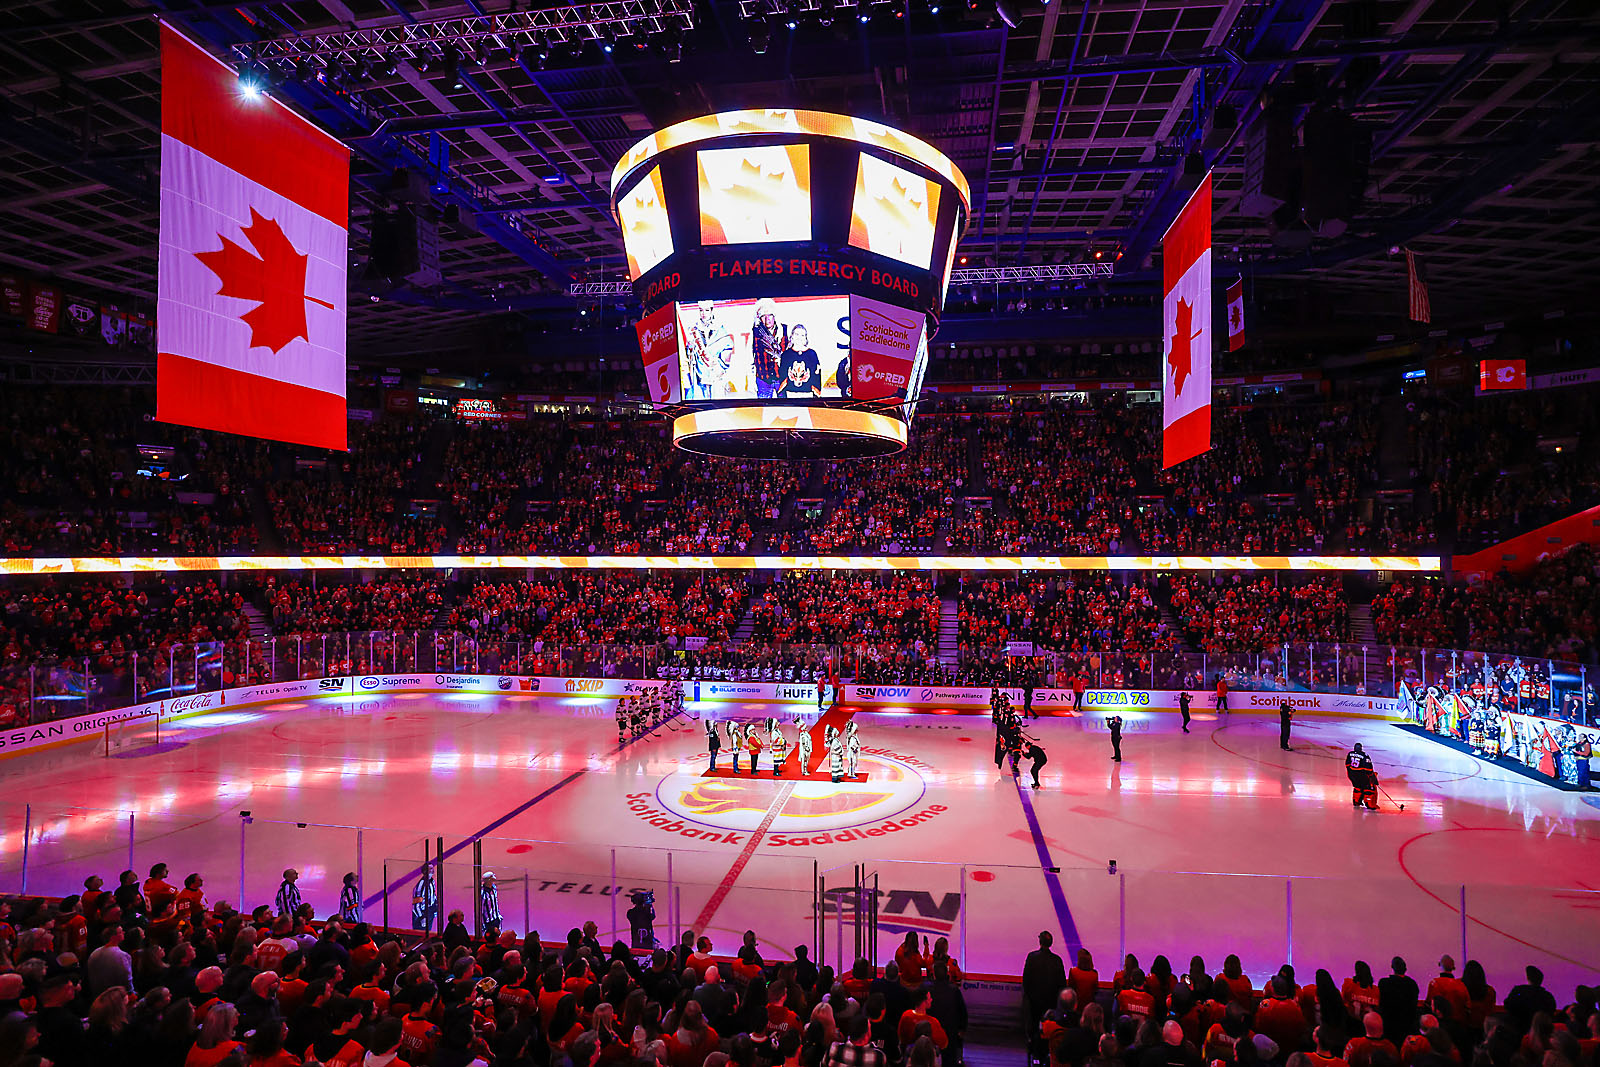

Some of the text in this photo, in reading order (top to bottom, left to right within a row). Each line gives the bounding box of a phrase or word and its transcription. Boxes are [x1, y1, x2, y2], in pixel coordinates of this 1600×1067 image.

[709, 259, 919, 298] FLAMES ENERGY BOARD
[659, 322, 674, 340] RED
[863, 320, 909, 341] Scotiabank
[859, 330, 911, 351] Saddledome
[874, 371, 885, 380] OF
[885, 372, 906, 385] RED
[318, 678, 344, 689] SN
[382, 677, 421, 686] Supreme
[446, 676, 480, 685] Desjardins
[576, 679, 604, 692] SKIP
[255, 688, 280, 696] TELUS
[783, 688, 813, 699] HUFF
[1005, 692, 1072, 702] NISAN
[1087, 692, 1150, 704] PIZZA 73
[1250, 695, 1321, 708] Scotiabank
[1375, 702, 1400, 711] ULT
[626, 792, 948, 847] Scotiabank Saddledome
[538, 881, 647, 898] TELUS
[811, 886, 962, 922] SN
